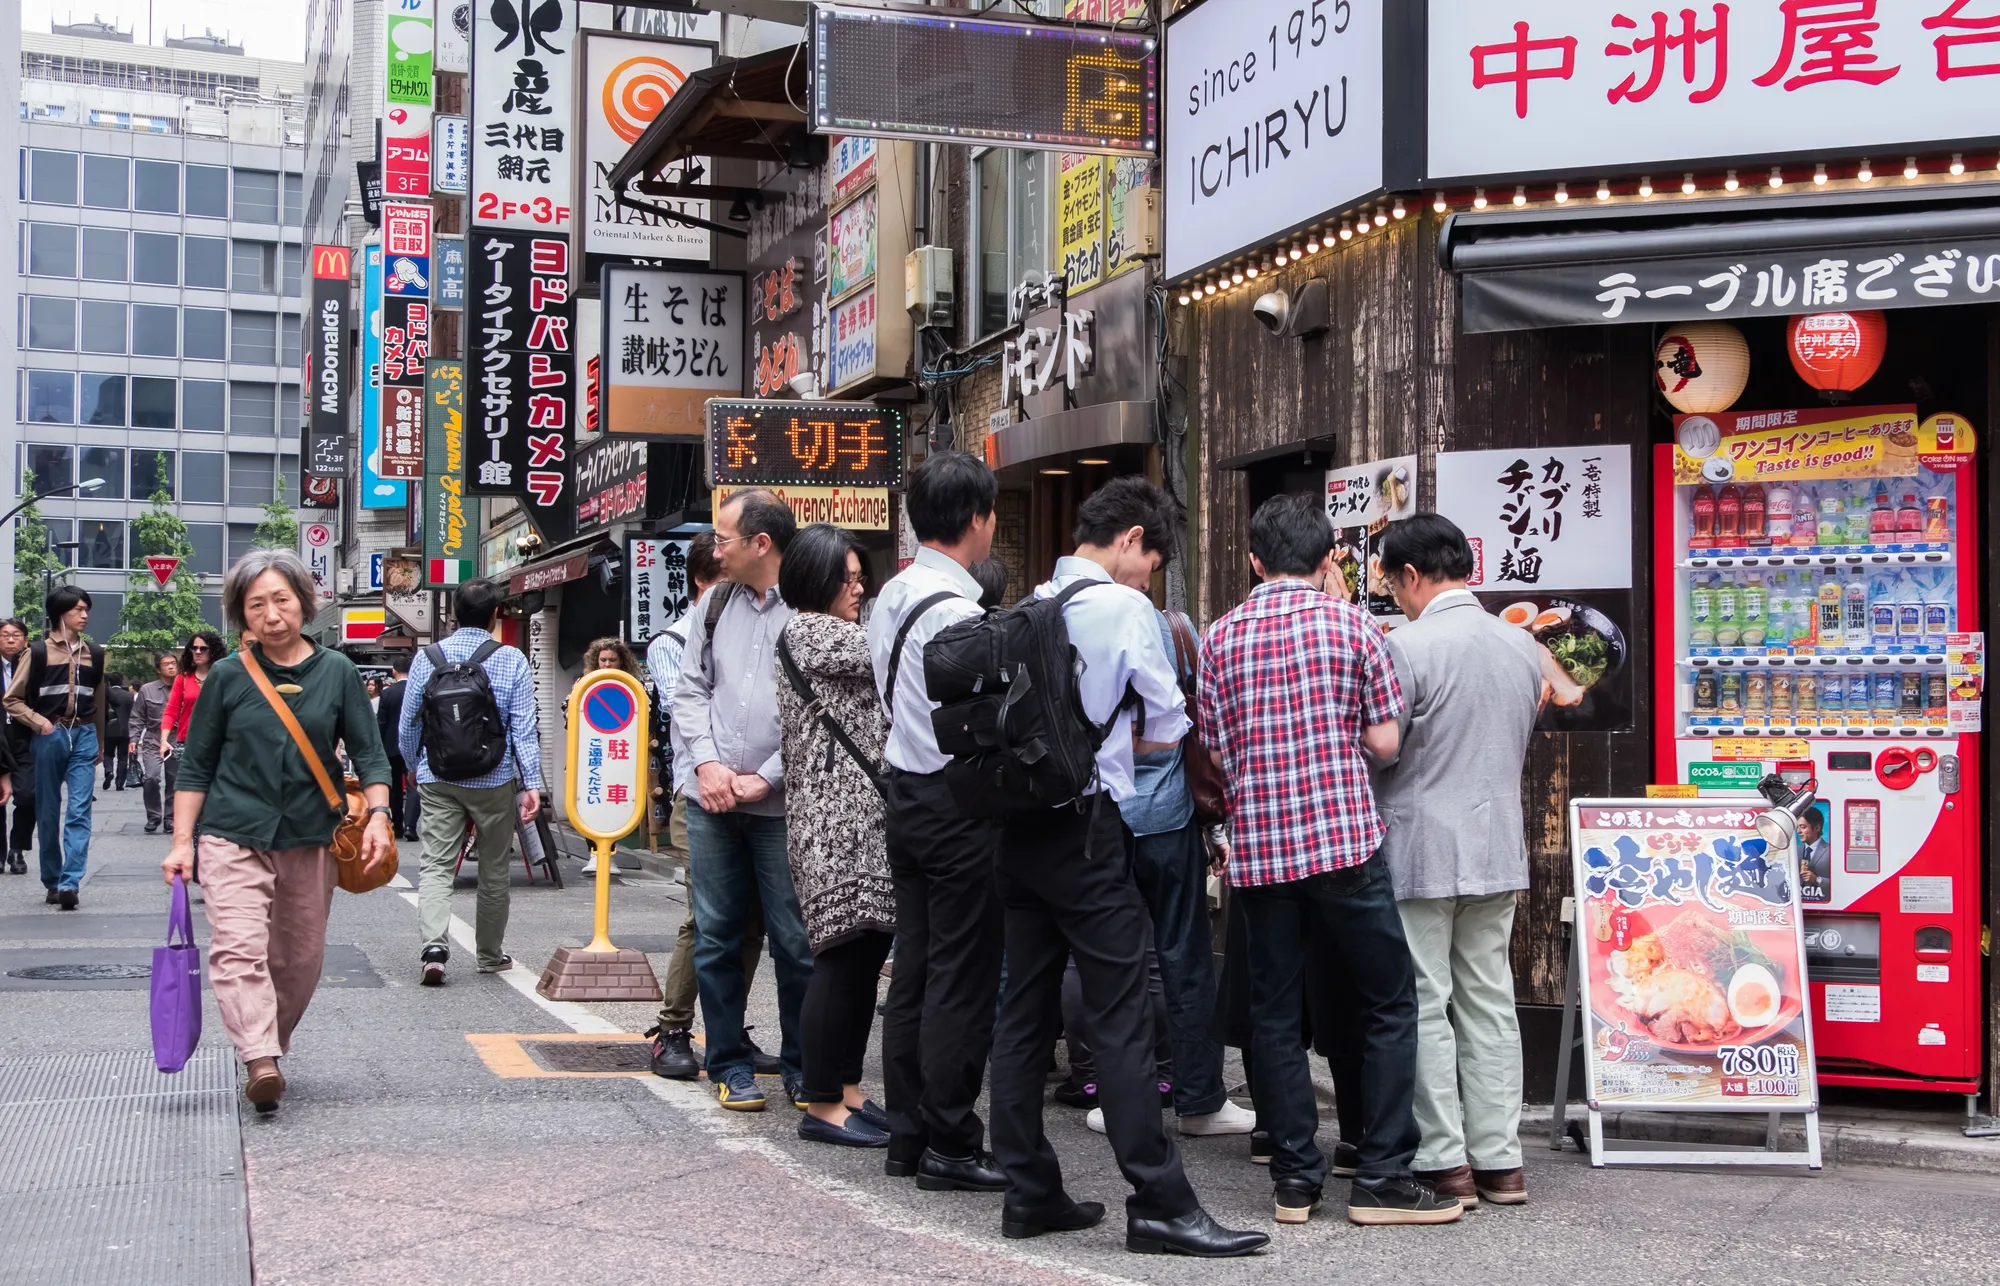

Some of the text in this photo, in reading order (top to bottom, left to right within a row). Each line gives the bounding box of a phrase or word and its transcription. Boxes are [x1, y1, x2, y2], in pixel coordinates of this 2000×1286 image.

[1188, 0, 1351, 116] since 1955
[390, 79, 429, 97] ピタットハウス
[1063, 48, 1140, 136] 店
[388, 146, 429, 162] アコム
[484, 122, 565, 152] 三代目
[1190, 75, 1348, 206] ICHIRYU
[398, 177, 419, 191] 3F
[497, 154, 552, 184] 網元
[393, 221, 422, 236] 高価
[393, 237, 422, 251] 買取
[593, 228, 630, 239] Oriental
[632, 231, 664, 242] Market
[677, 234, 704, 244] Bistro
[388, 277, 405, 290] 2F
[623, 282, 728, 327] 生そば
[764, 256, 796, 320] そば
[1009, 271, 1062, 326] ステーキ
[1596, 248, 2000, 319] テーブル席ござい
[321, 299, 339, 414] McDonald's
[384, 326, 405, 380] カメラ
[405, 303, 428, 376] ヨドバシ
[478, 238, 514, 485] ケータイアクセサリー館
[621, 334, 729, 377] 讃岐うどん
[760, 331, 799, 396] うどん
[1803, 348, 1851, 361] ラーメン
[526, 238, 569, 507] ヨドバシカメラ
[785, 417, 888, 470] 切手
[1730, 418, 1915, 462] ワンコインコーヒーあります
[1735, 410, 1798, 432] 期間限定
[575, 441, 647, 496] ケータイアクセサリー館
[1756, 445, 1875, 475] Taste is good!!
[303, 498, 317, 507] 4F
[600, 471, 647, 525] ヨドバシカメラ
[1328, 492, 1371, 517] ラーメン
[1540, 456, 1571, 542] カブリ
[1581, 456, 1603, 518] 一竜特製
[1494, 458, 1543, 584] チャーシュー麺
[637, 541, 655, 554] 3F
[637, 555, 656, 567] 2F
[637, 572, 651, 640] 三代目網元
[661, 542, 689, 623] 魚鮮水
[587, 738, 602, 805] ご遠慮ください
[607, 739, 629, 805] 駐車
[1646, 831, 1703, 854] ピリ辛
[1583, 833, 1792, 912] 冷やし麺
[1728, 909, 1789, 925] 期間限定
[1777, 1047, 1797, 1056] 税込
[1725, 1082, 1745, 1093] 大盛
